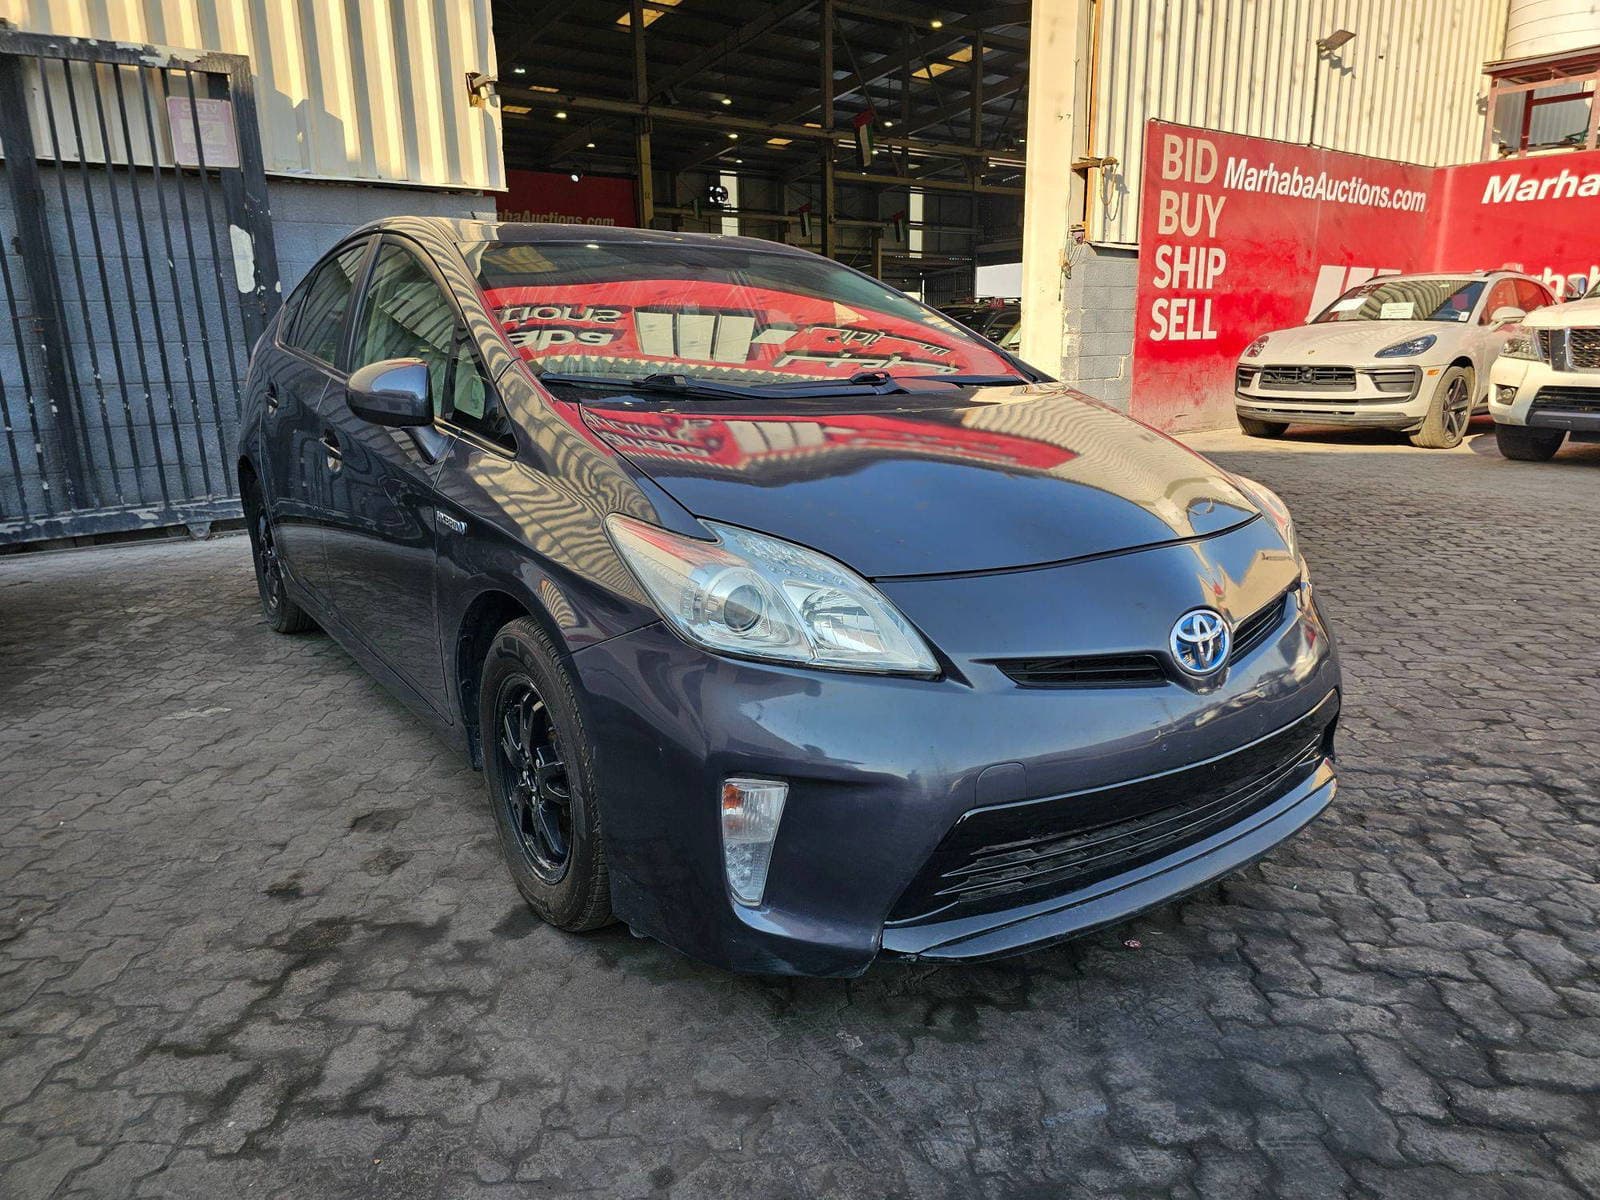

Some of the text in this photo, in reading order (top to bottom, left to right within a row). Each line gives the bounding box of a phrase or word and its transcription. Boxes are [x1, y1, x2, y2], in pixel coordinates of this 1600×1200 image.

[1162, 134, 1219, 184] BID
[1223, 156, 1426, 213] MarhabaAuctions.com
[1158, 190, 1227, 238] BUY
[1153, 244, 1226, 290] SHIP
[1149, 298, 1217, 342] SELL
